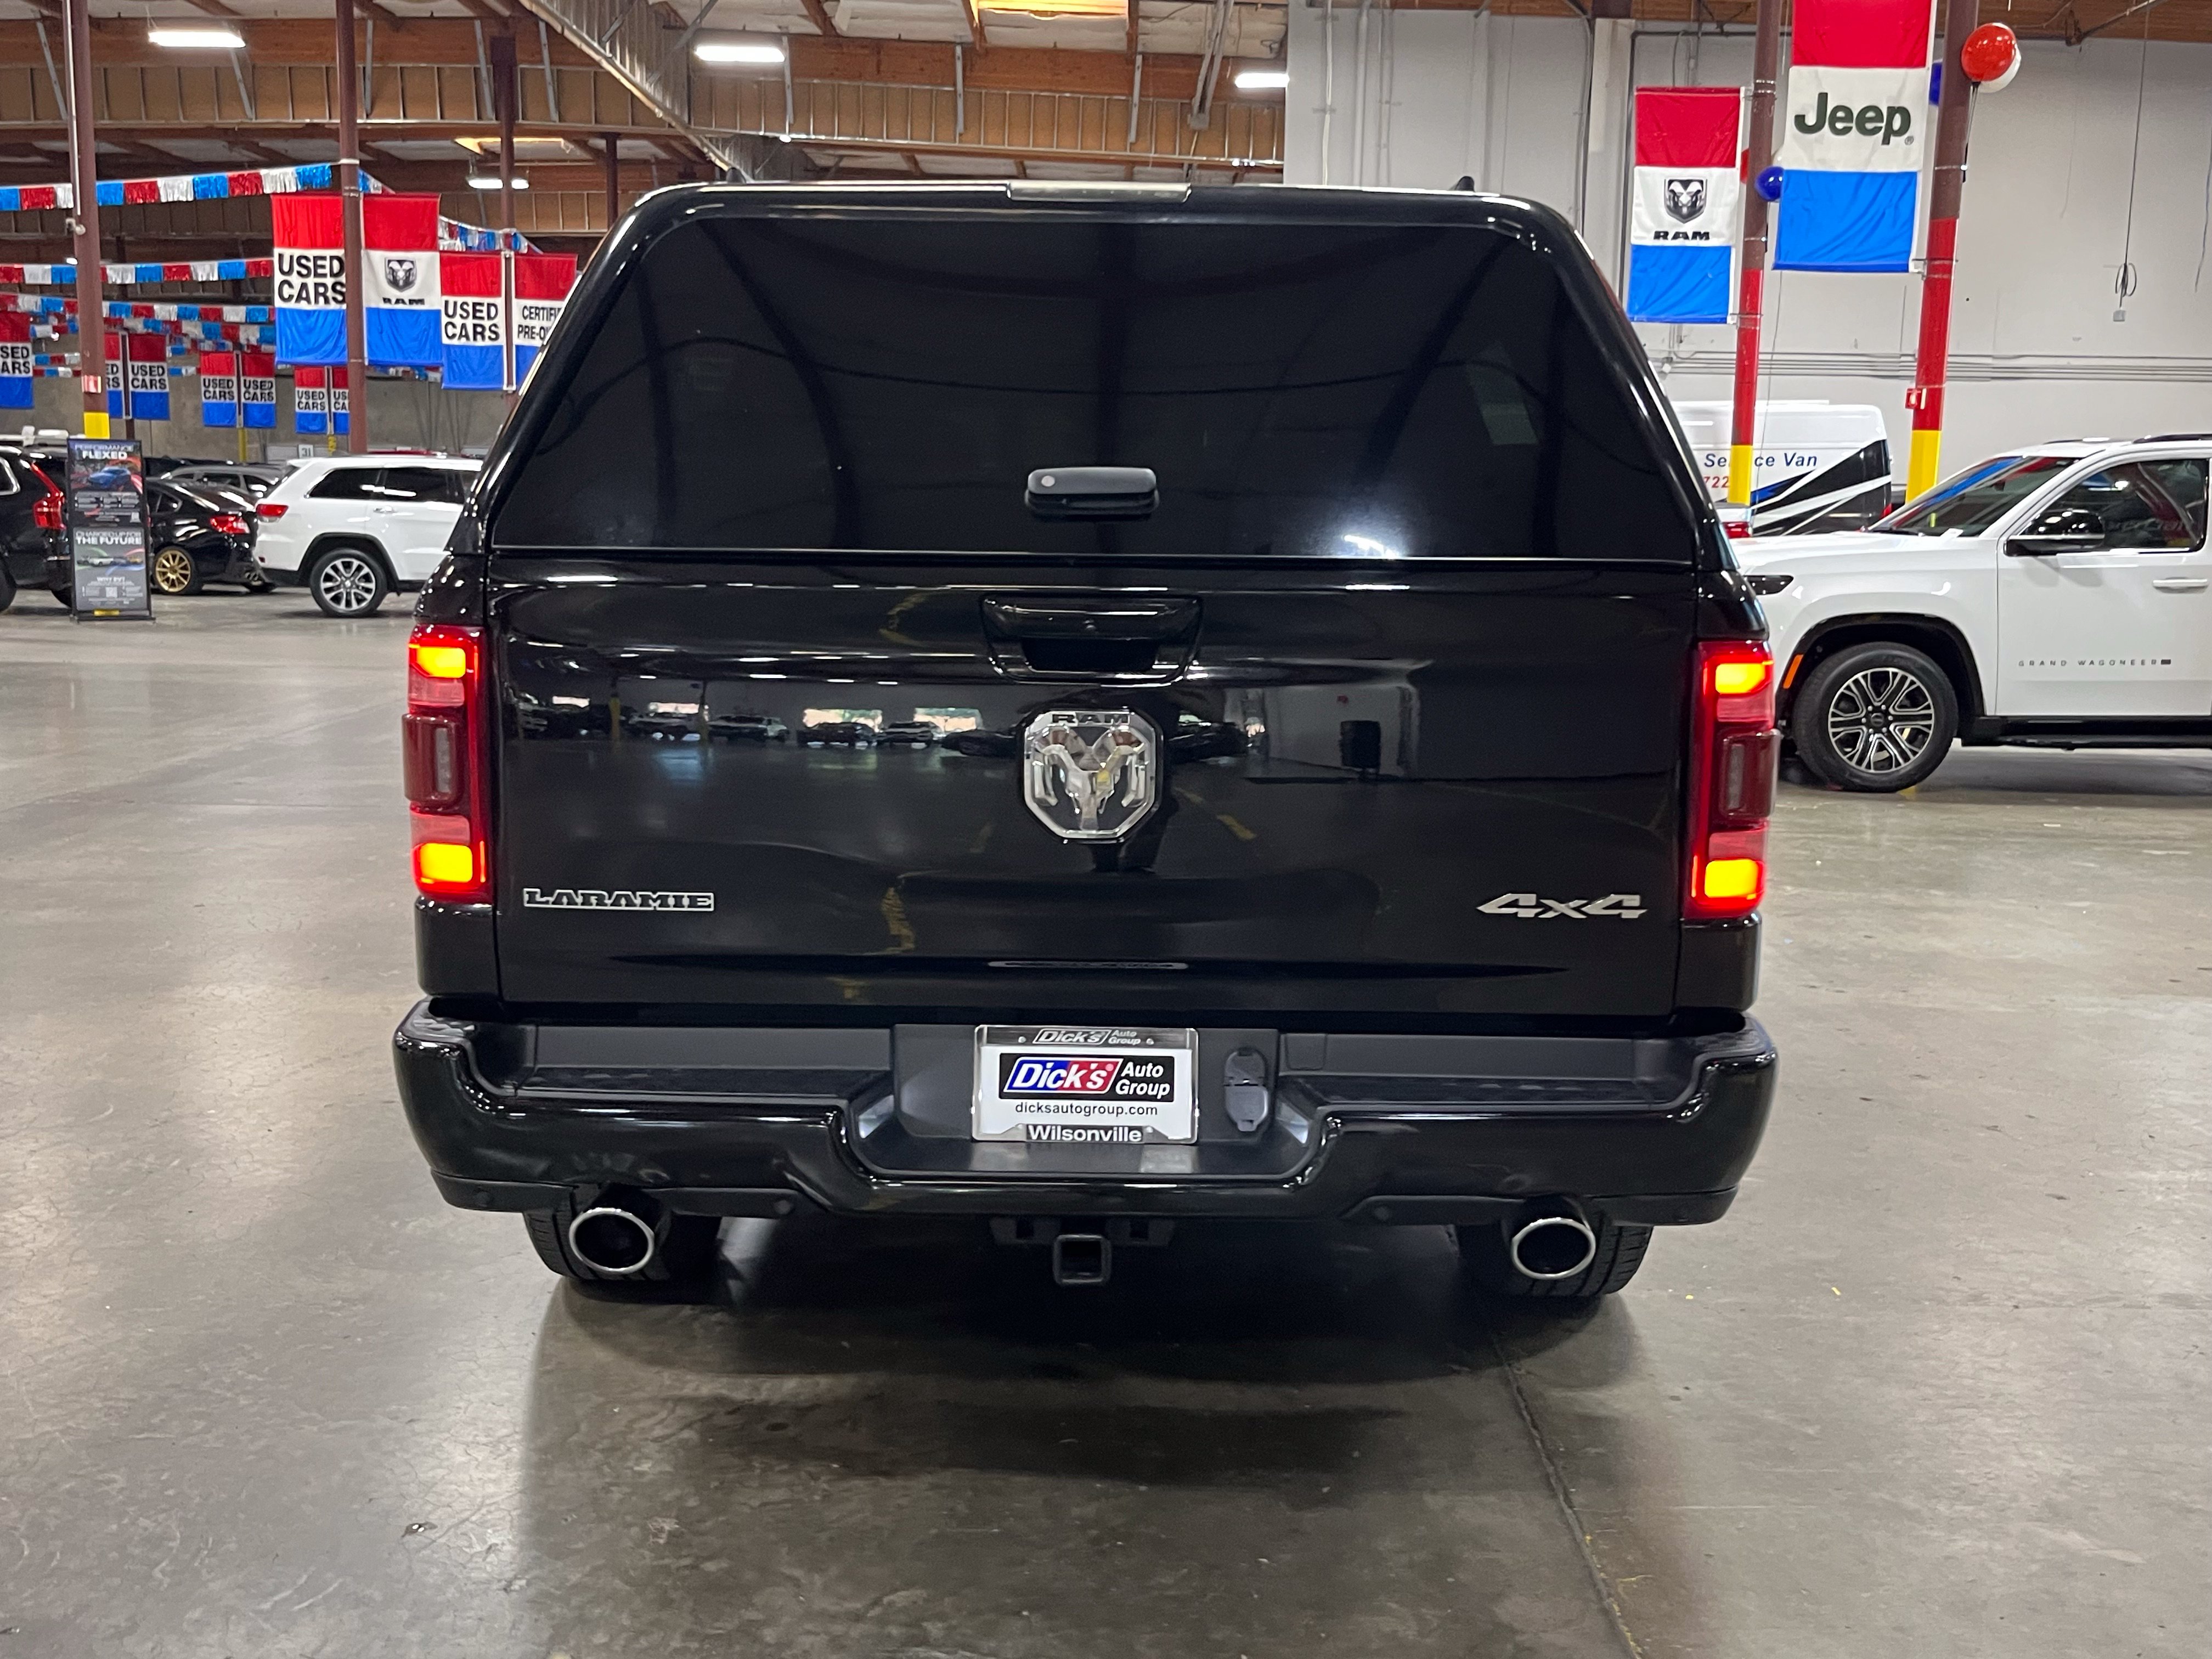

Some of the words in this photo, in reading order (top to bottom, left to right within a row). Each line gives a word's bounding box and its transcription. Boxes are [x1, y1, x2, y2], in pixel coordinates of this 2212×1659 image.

[1654, 230, 1710, 240] RAM
[278, 253, 345, 279] USED
[278, 280, 346, 305] CARS
[444, 300, 499, 321] USED
[522, 305, 561, 321] CERTIFI
[444, 322, 500, 342] CARS
[517, 324, 548, 341] PRE-O
[0, 346, 30, 359] SED
[0, 361, 31, 374] ARS
[131, 364, 165, 377] USED
[131, 377, 167, 390] CARS
[203, 378, 234, 390] USED
[243, 379, 273, 390] USED
[204, 390, 235, 400] CARS
[243, 391, 274, 402] CARS
[297, 390, 325, 400] USED
[333, 390, 347, 400] US
[297, 401, 326, 411] CARS
[333, 401, 347, 410] CA
[82, 450, 127, 460] FLEXED
[1704, 453, 1775, 467] Sece
[1784, 452, 1818, 467] Van
[76, 537, 98, 545] THE
[99, 537, 142, 545] FUTURE
[1052, 714, 1129, 724] RAM
[523, 888, 714, 912] LARAMIE
[1038, 1030, 1104, 1043] Dick's
[1108, 1036, 1141, 1046] Group
[1013, 1061, 1108, 1089] Dick's
[1121, 1062, 1164, 1078] Auto
[1115, 1080, 1171, 1099] Group
[1015, 1101, 1158, 1118] dicksautogroup.com
[1028, 1125, 1142, 1142] Wilsonville
